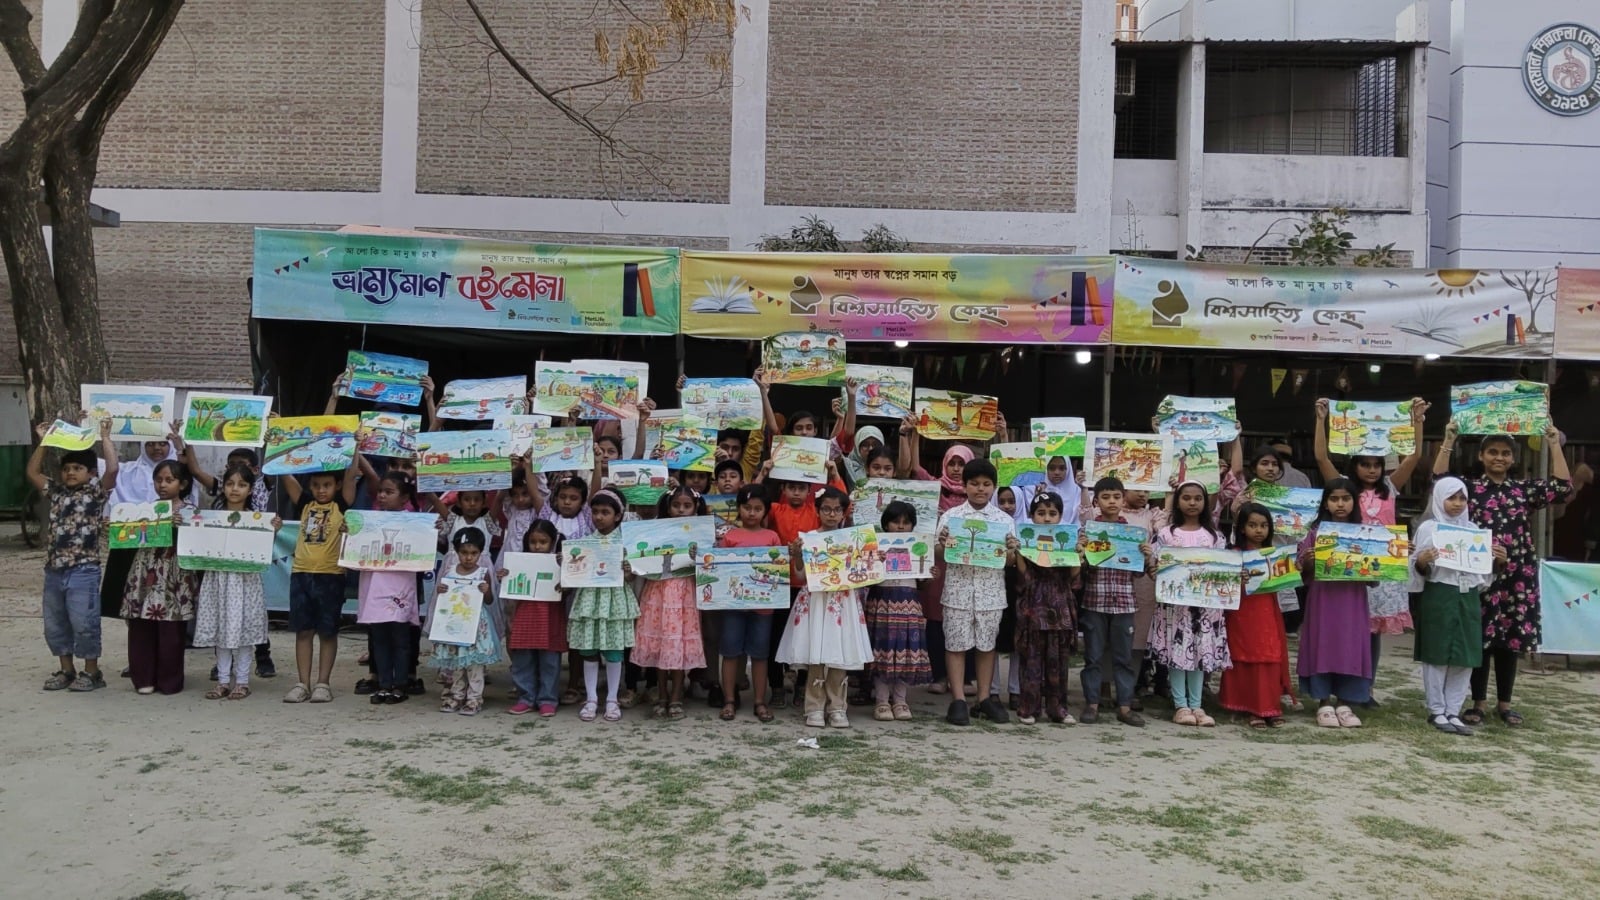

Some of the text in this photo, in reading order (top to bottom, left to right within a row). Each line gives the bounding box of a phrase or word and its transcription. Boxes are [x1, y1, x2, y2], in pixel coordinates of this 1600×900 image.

[1550, 93, 1590, 110] ১৯২৪
[344, 246, 437, 258] আলোকিত মানুষ চাই
[481, 254, 499, 263] মানুষ
[501, 255, 514, 263] তার
[537, 256, 555, 265] সমান
[557, 257, 568, 267] বড়
[833, 268, 958, 282] মানুষ তার স্বপ্নের সমান বড়
[331, 266, 566, 311] ভ্রাম্যমাণ বইমেলা
[1226, 277, 1355, 292] আলোকিত মানুষ চাই
[830, 293, 1010, 326] বিশ্বসাহিত্য কেন্দ্র
[1204, 297, 1366, 330] বিশ্বসাহিত্য কেন্দ্র
